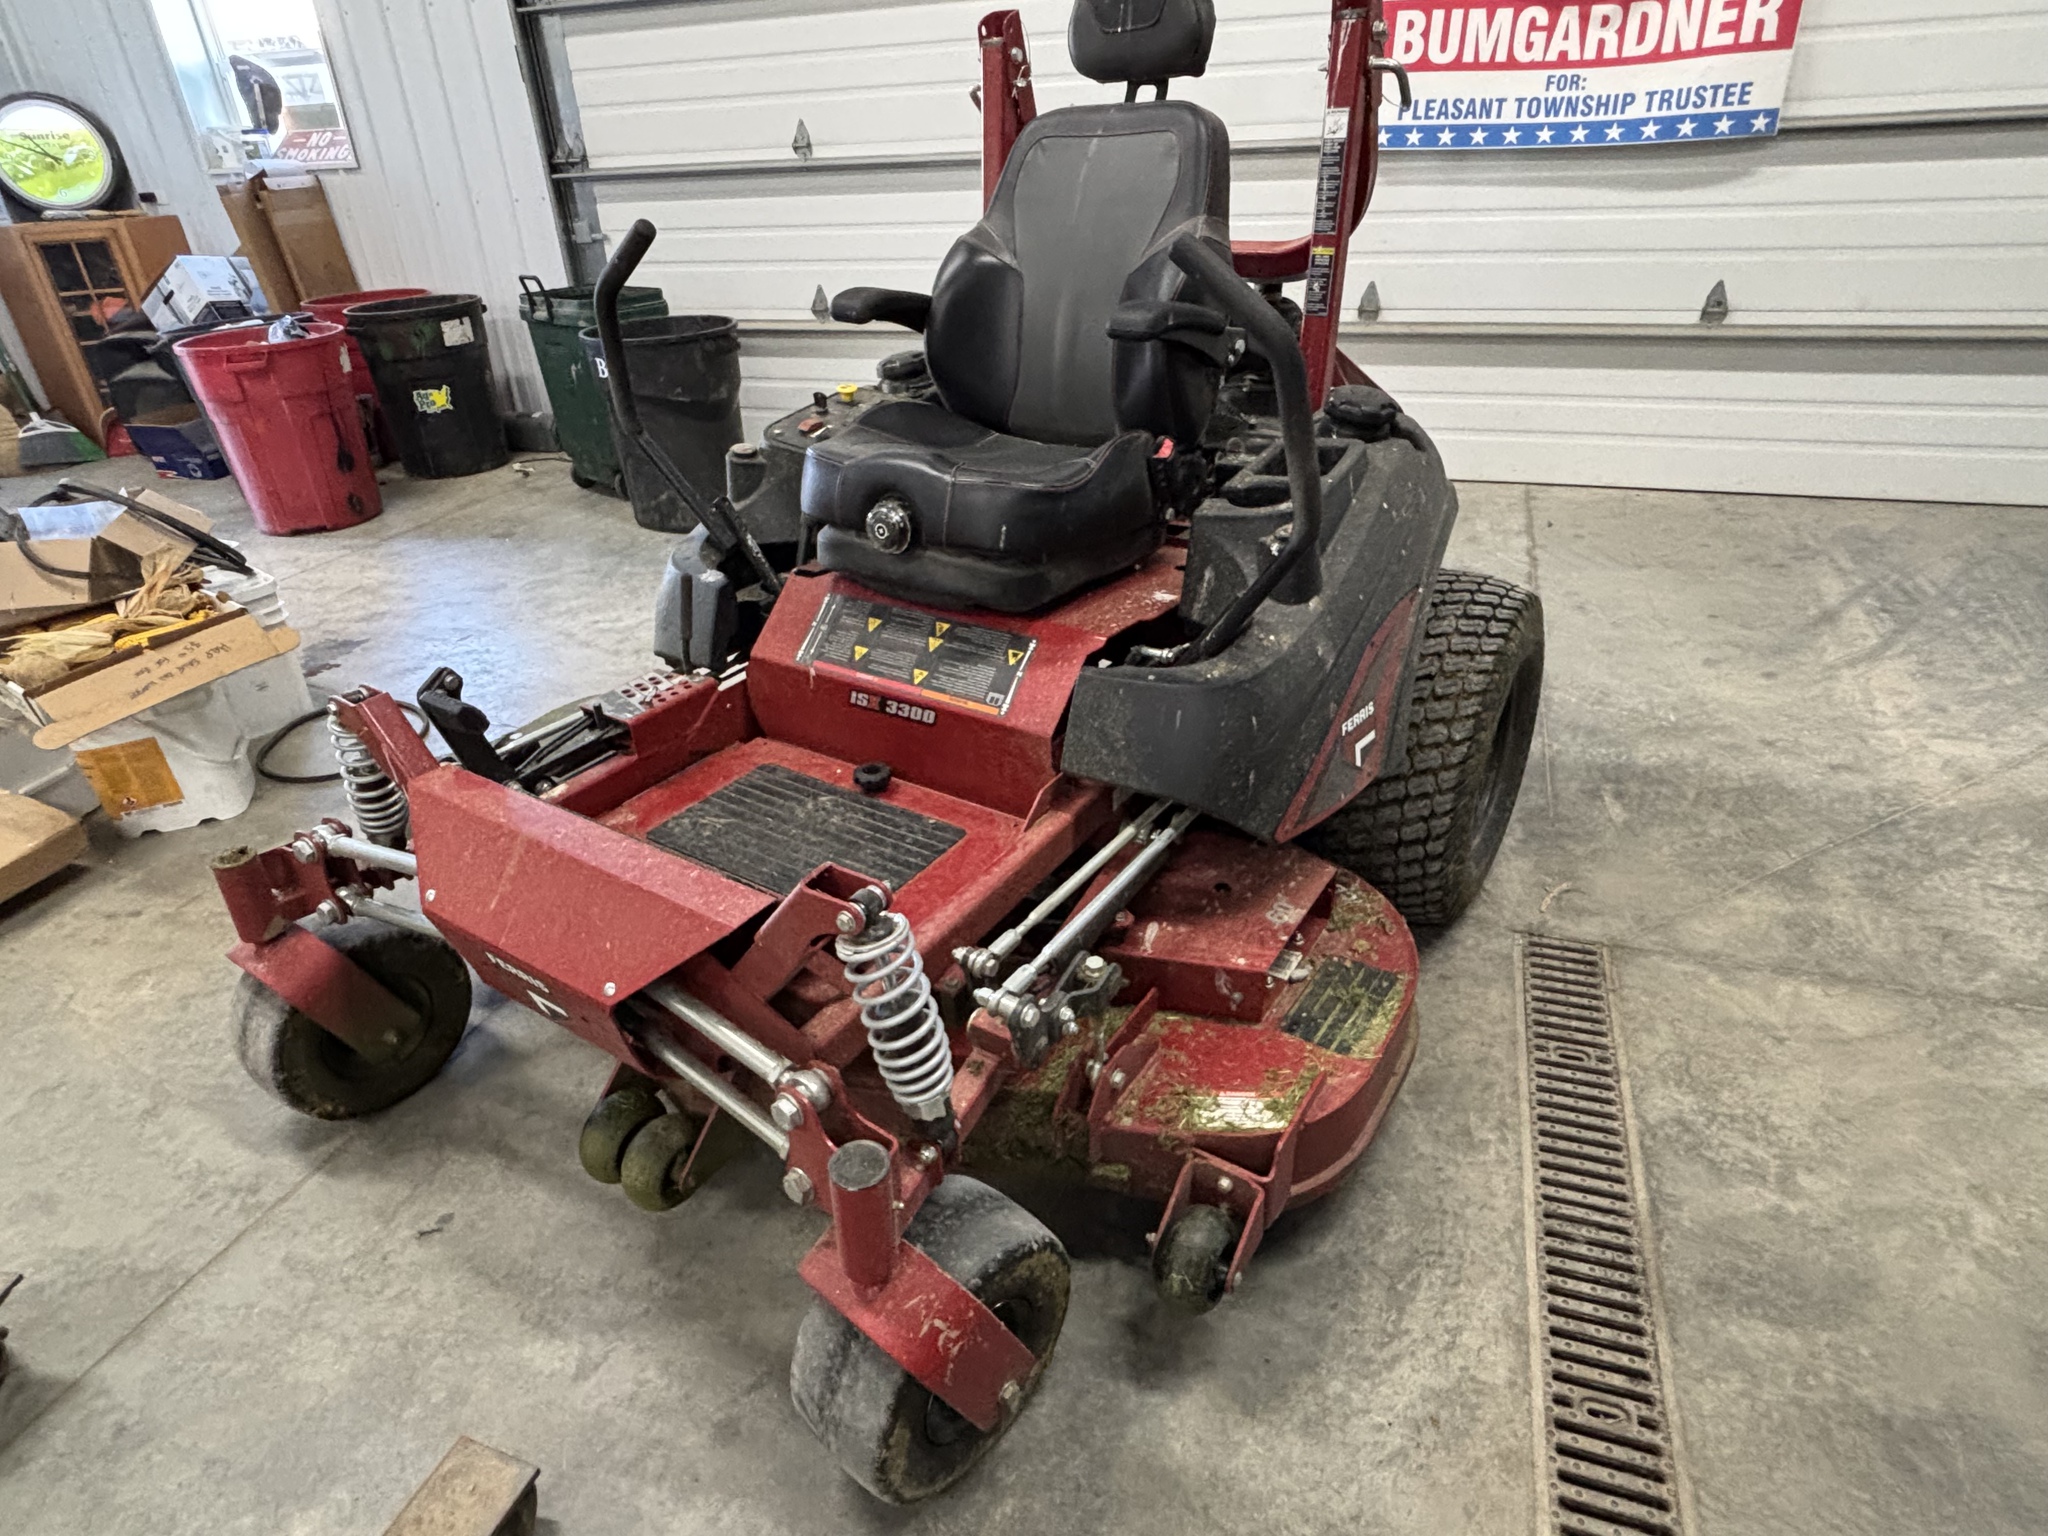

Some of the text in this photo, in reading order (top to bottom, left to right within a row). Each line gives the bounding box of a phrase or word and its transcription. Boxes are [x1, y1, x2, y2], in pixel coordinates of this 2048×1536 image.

[1391, 0, 1782, 65] BUMGARDNER
[1545, 73, 1587, 92] FOR:
[1514, 92, 1636, 119] TOWNSHIP
[1645, 81, 1753, 113] TRUSTEE
[276, 143, 350, 161] SMOKING
[306, 131, 333, 148] NO
[884, 700, 937, 725] 3300
[1341, 700, 1375, 737] FERRIS
